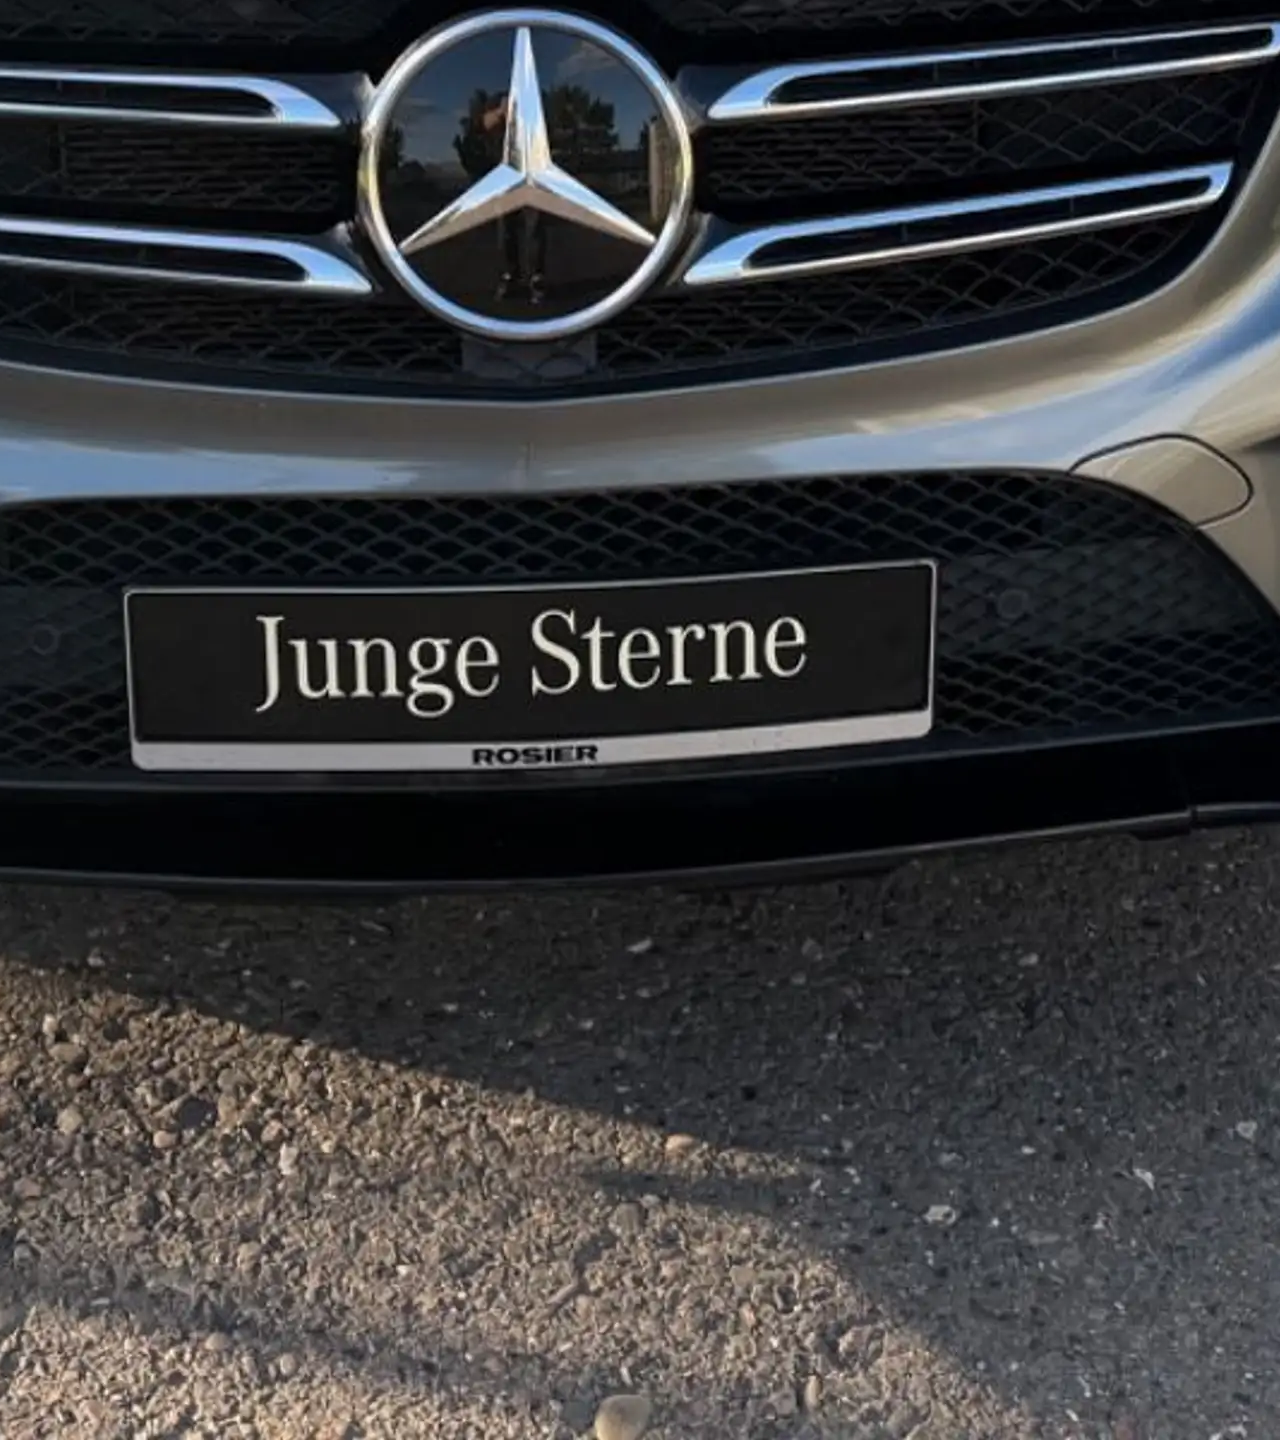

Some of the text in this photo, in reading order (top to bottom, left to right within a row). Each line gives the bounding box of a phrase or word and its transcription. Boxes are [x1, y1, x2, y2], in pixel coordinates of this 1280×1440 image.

[255, 609, 808, 718] Junge Sterne
[472, 744, 598, 766] ROSIER
